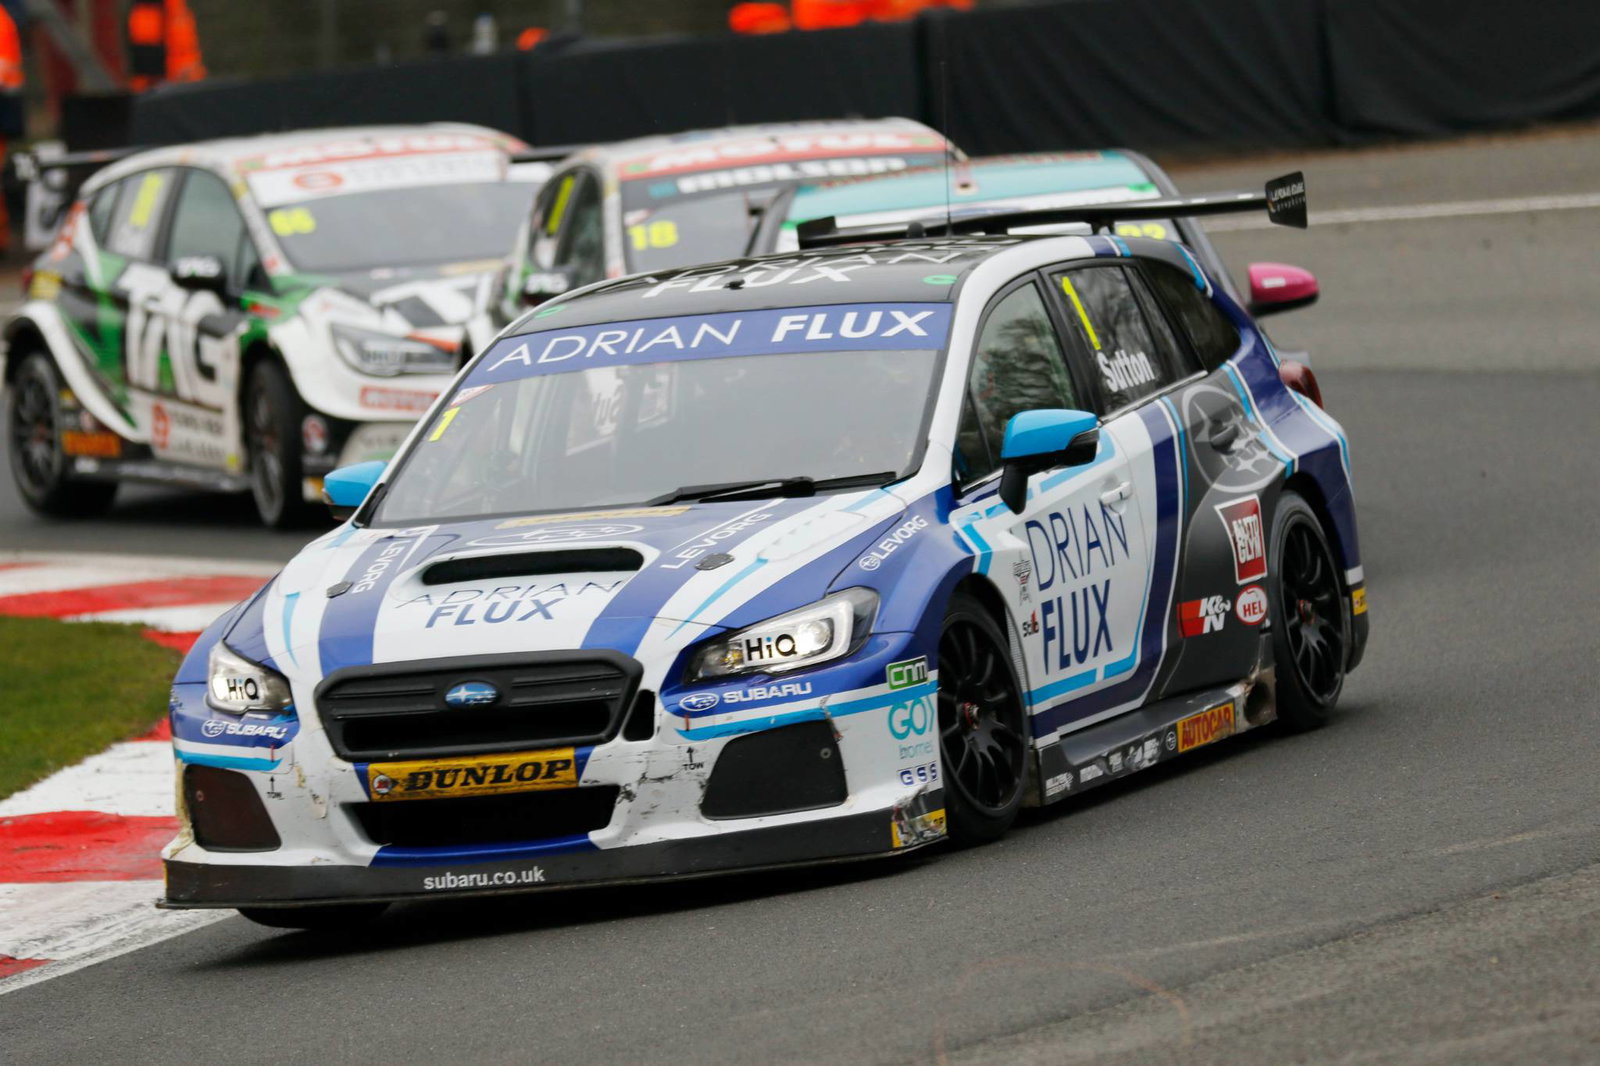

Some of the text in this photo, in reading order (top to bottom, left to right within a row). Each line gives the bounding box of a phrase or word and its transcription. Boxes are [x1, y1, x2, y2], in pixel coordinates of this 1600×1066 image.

[628, 221, 679, 250] 18
[642, 264, 875, 298] FLUX
[1062, 276, 1102, 350] 1
[486, 310, 936, 372] ADRIAN FLUX
[1097, 349, 1156, 393] Sutton
[428, 406, 461, 442] 1
[660, 511, 774, 569] LEVORG
[877, 514, 929, 560] LEVORG
[1024, 497, 1130, 592] DRIAN
[352, 540, 412, 594] LEVORG
[395, 580, 624, 609] ADRIAN
[1243, 601, 1264, 618] HEL
[425, 597, 565, 629] FLUX
[1041, 578, 1113, 676] FLUX
[745, 633, 798, 662] HiQ
[226, 677, 260, 701] HiQ
[723, 681, 813, 704] SUBARU
[224, 721, 288, 739] SUBARU
[1181, 706, 1232, 749] AUTOCAR
[404, 758, 572, 792] DUNLOP
[682, 762, 704, 772] TOW
[423, 865, 546, 891] subaru.co.uk
